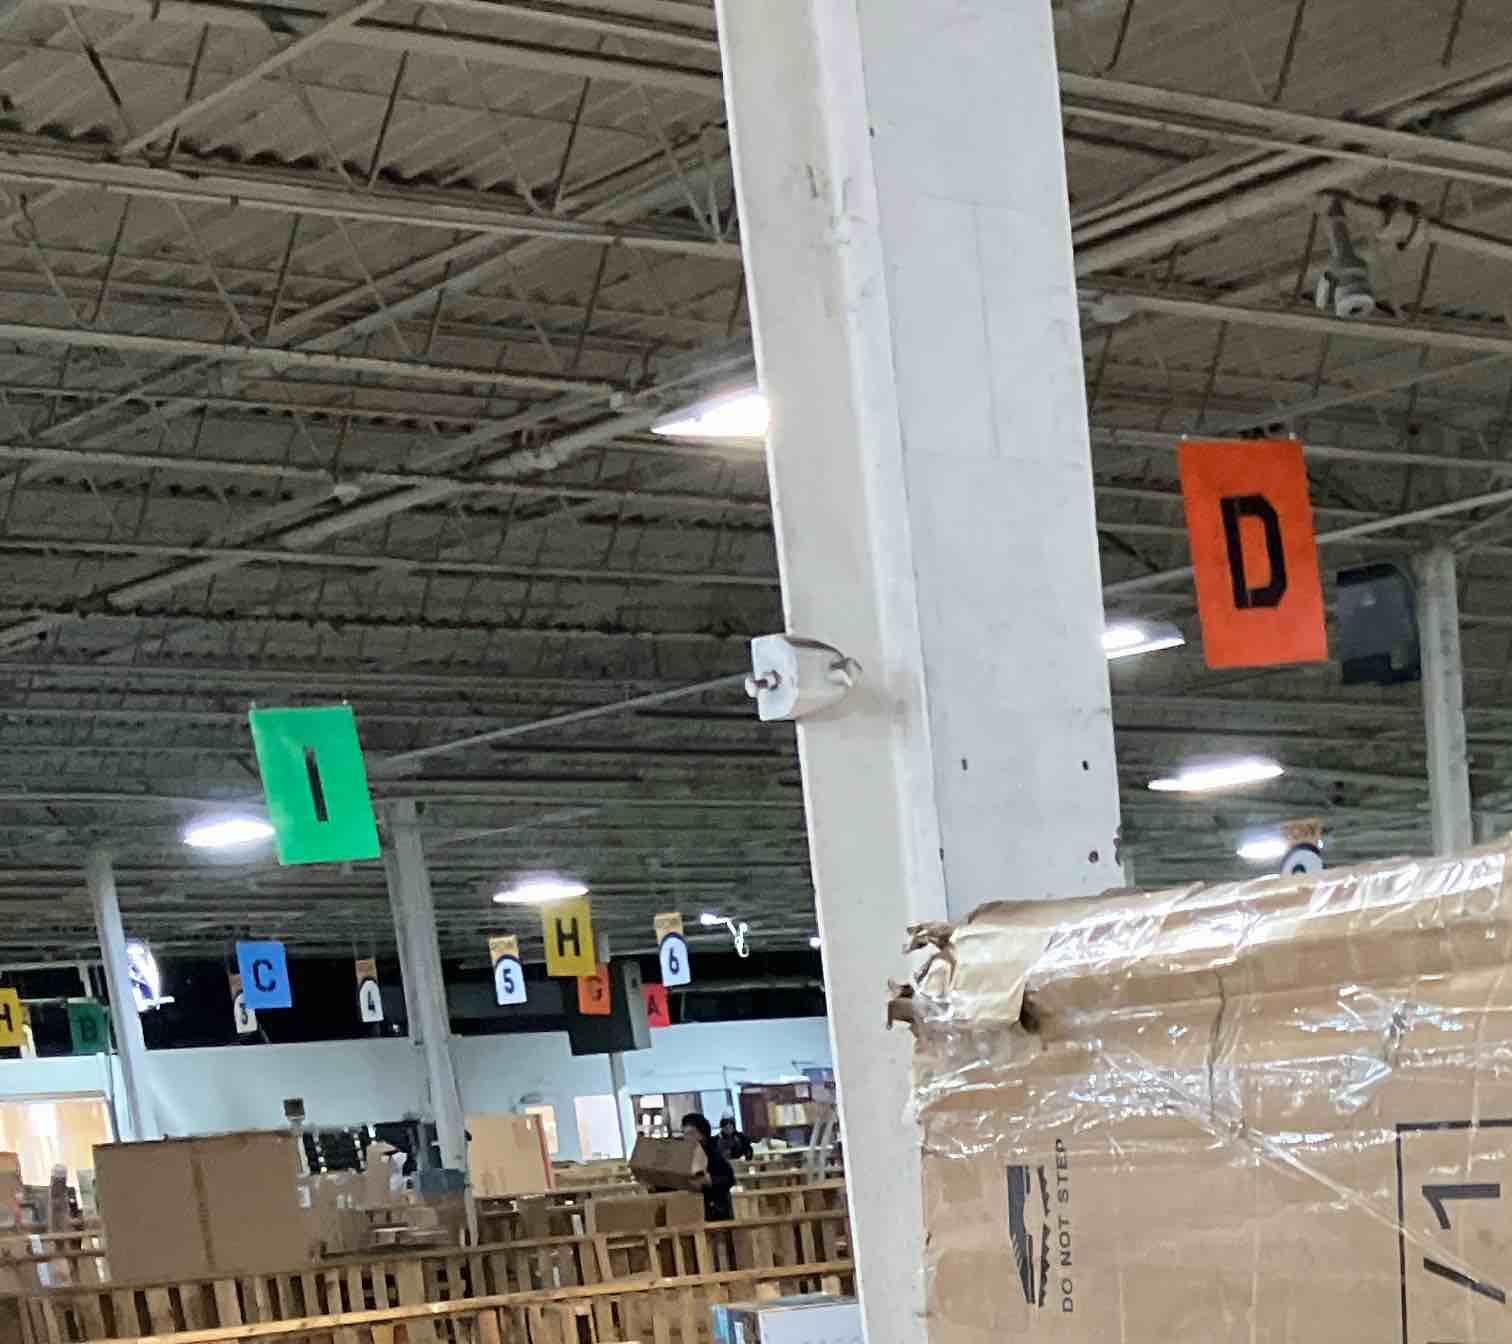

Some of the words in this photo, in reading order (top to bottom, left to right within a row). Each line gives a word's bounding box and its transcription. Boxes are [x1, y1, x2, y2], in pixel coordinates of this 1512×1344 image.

[1220, 495, 1288, 610] D
[303, 744, 330, 822] I
[555, 917, 581, 957] H
[252, 959, 276, 992] C
[667, 947, 680, 975] 6
[502, 969, 515, 994] 5
[1055, 1138, 1069, 1203] STEP
[1058, 1216, 1072, 1266] NOT
[1061, 1278, 1073, 1313] DO
